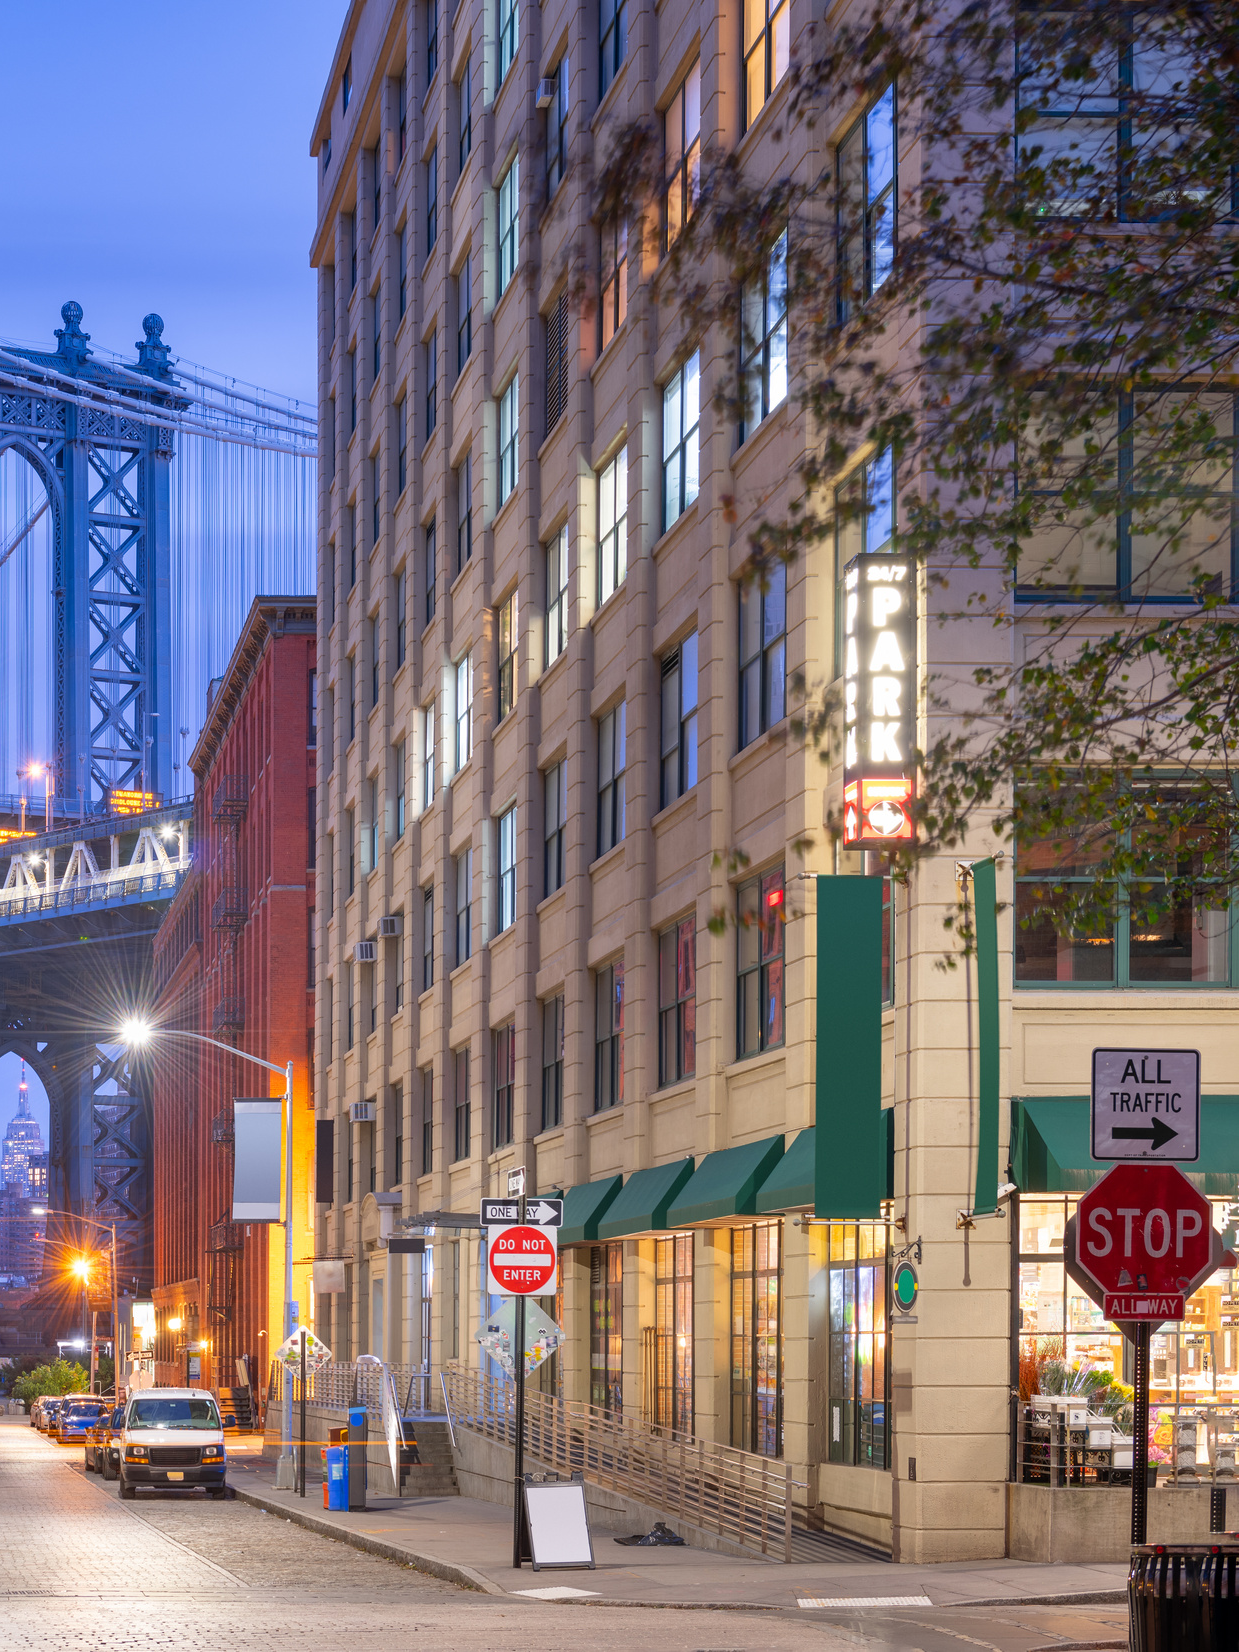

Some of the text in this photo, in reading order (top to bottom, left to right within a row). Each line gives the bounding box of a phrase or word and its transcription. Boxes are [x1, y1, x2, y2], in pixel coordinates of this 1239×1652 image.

[869, 587, 906, 762] PARK
[1120, 1059, 1172, 1084] ALL
[1110, 1092, 1182, 1113] TRAFFIC
[490, 1207, 512, 1218] ONE
[1086, 1207, 1203, 1258] STOP
[499, 1239, 546, 1251] DO NOT
[503, 1269, 541, 1281] ENTER
[1110, 1298, 1178, 1315] ALL WAY
